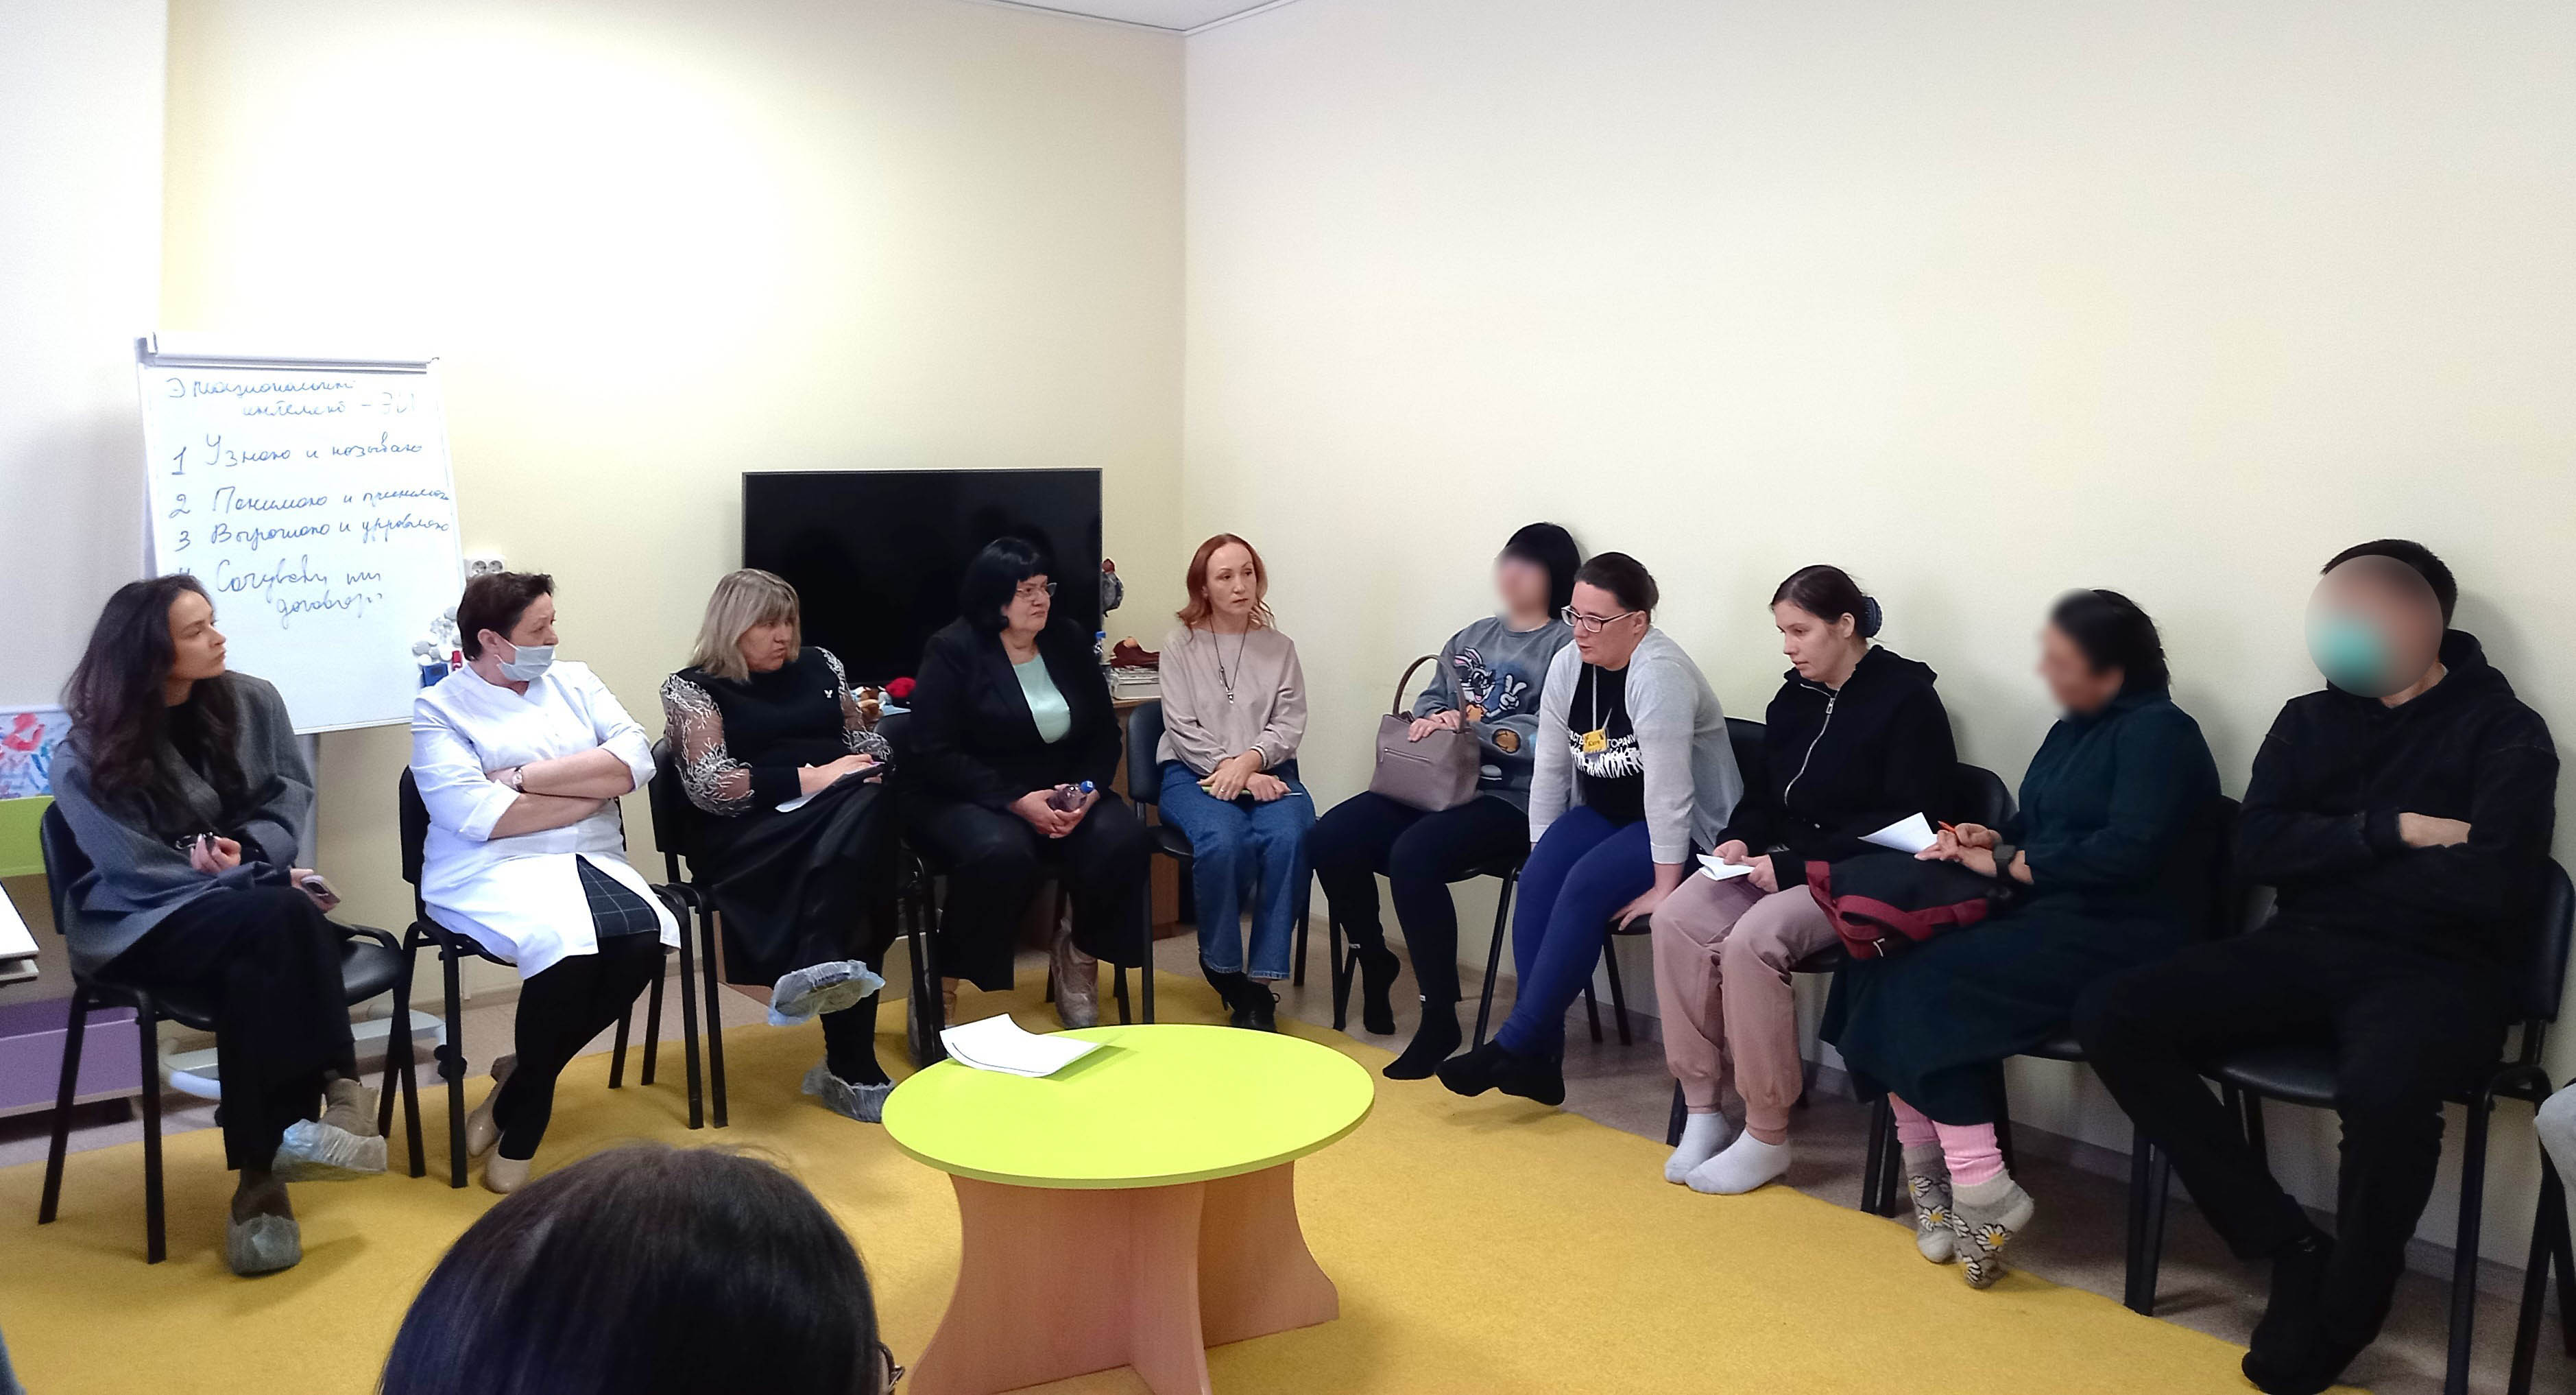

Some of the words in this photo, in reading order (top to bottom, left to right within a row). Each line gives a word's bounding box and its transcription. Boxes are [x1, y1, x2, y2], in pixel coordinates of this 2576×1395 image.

[171, 446, 186, 475] 1
[206, 433, 291, 466] Узнаю
[306, 447, 319, 458] и
[169, 494, 191, 518] 2
[344, 494, 353, 504] и
[176, 530, 191, 551] 3
[340, 521, 351, 533] и
